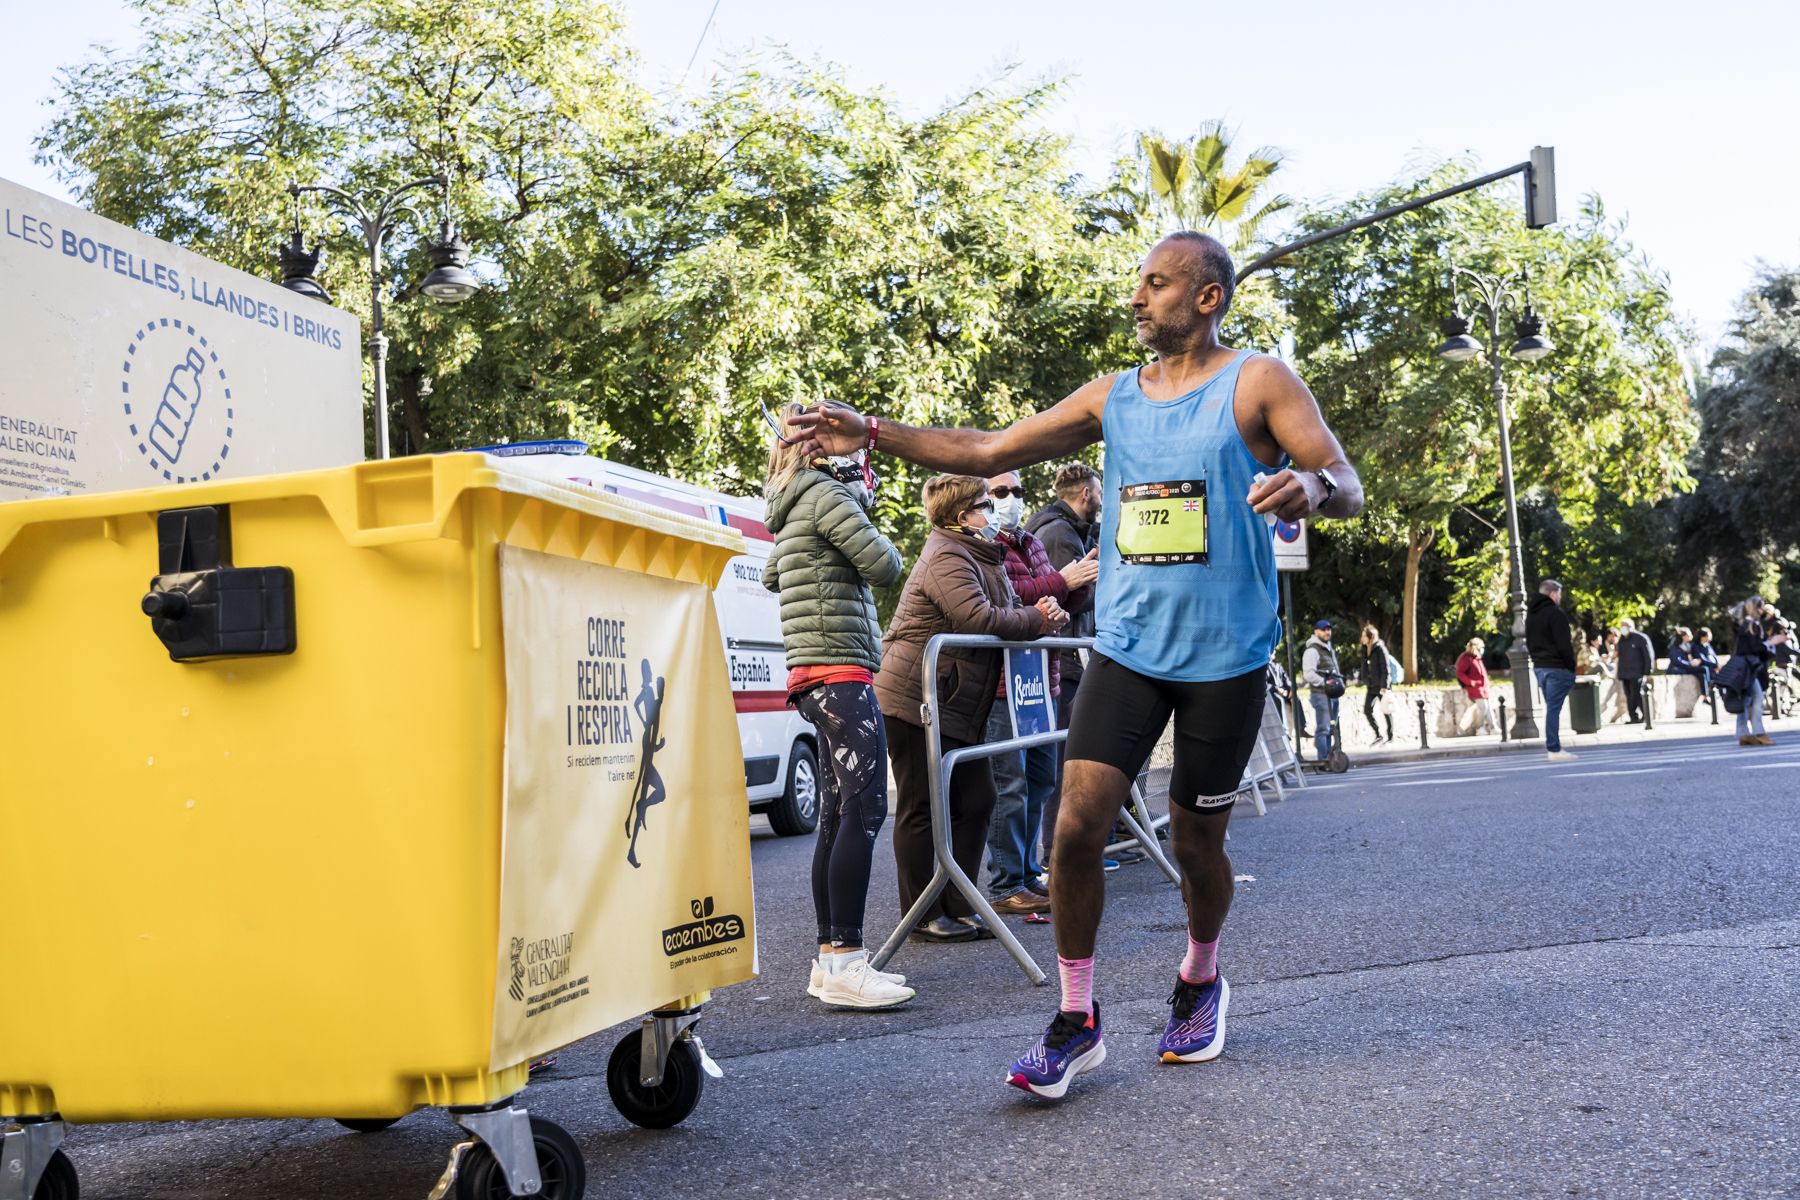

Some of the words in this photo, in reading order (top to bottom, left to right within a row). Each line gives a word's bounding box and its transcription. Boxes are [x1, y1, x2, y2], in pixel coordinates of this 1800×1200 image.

[6, 208, 54, 249] LES
[62, 229, 185, 300] BOTELLES,
[191, 276, 279, 328] LLANDES
[284, 311, 288, 332] I
[294, 314, 342, 350] BRIKS
[0, 415, 78, 445] ENERALITAT
[0, 435, 77, 462] ALENCIANA
[1138, 509, 1170, 526] 3272
[746, 565, 760, 582] 222
[587, 616, 627, 659] CORRE
[577, 660, 629, 701] RECICLA
[731, 655, 771, 690] Española
[567, 705, 572, 746] I
[577, 704, 633, 746] RESPIRA
[567, 755, 574, 768] Si
[575, 754, 602, 767] reciclem
[602, 752, 636, 765] mantenim
[626, 770, 636, 781] net
[526, 932, 574, 965] GENERALITAT
[665, 918, 740, 951] ecoembes
[697, 946, 738, 961] colaboración
[527, 956, 571, 988] VALENCIANA
